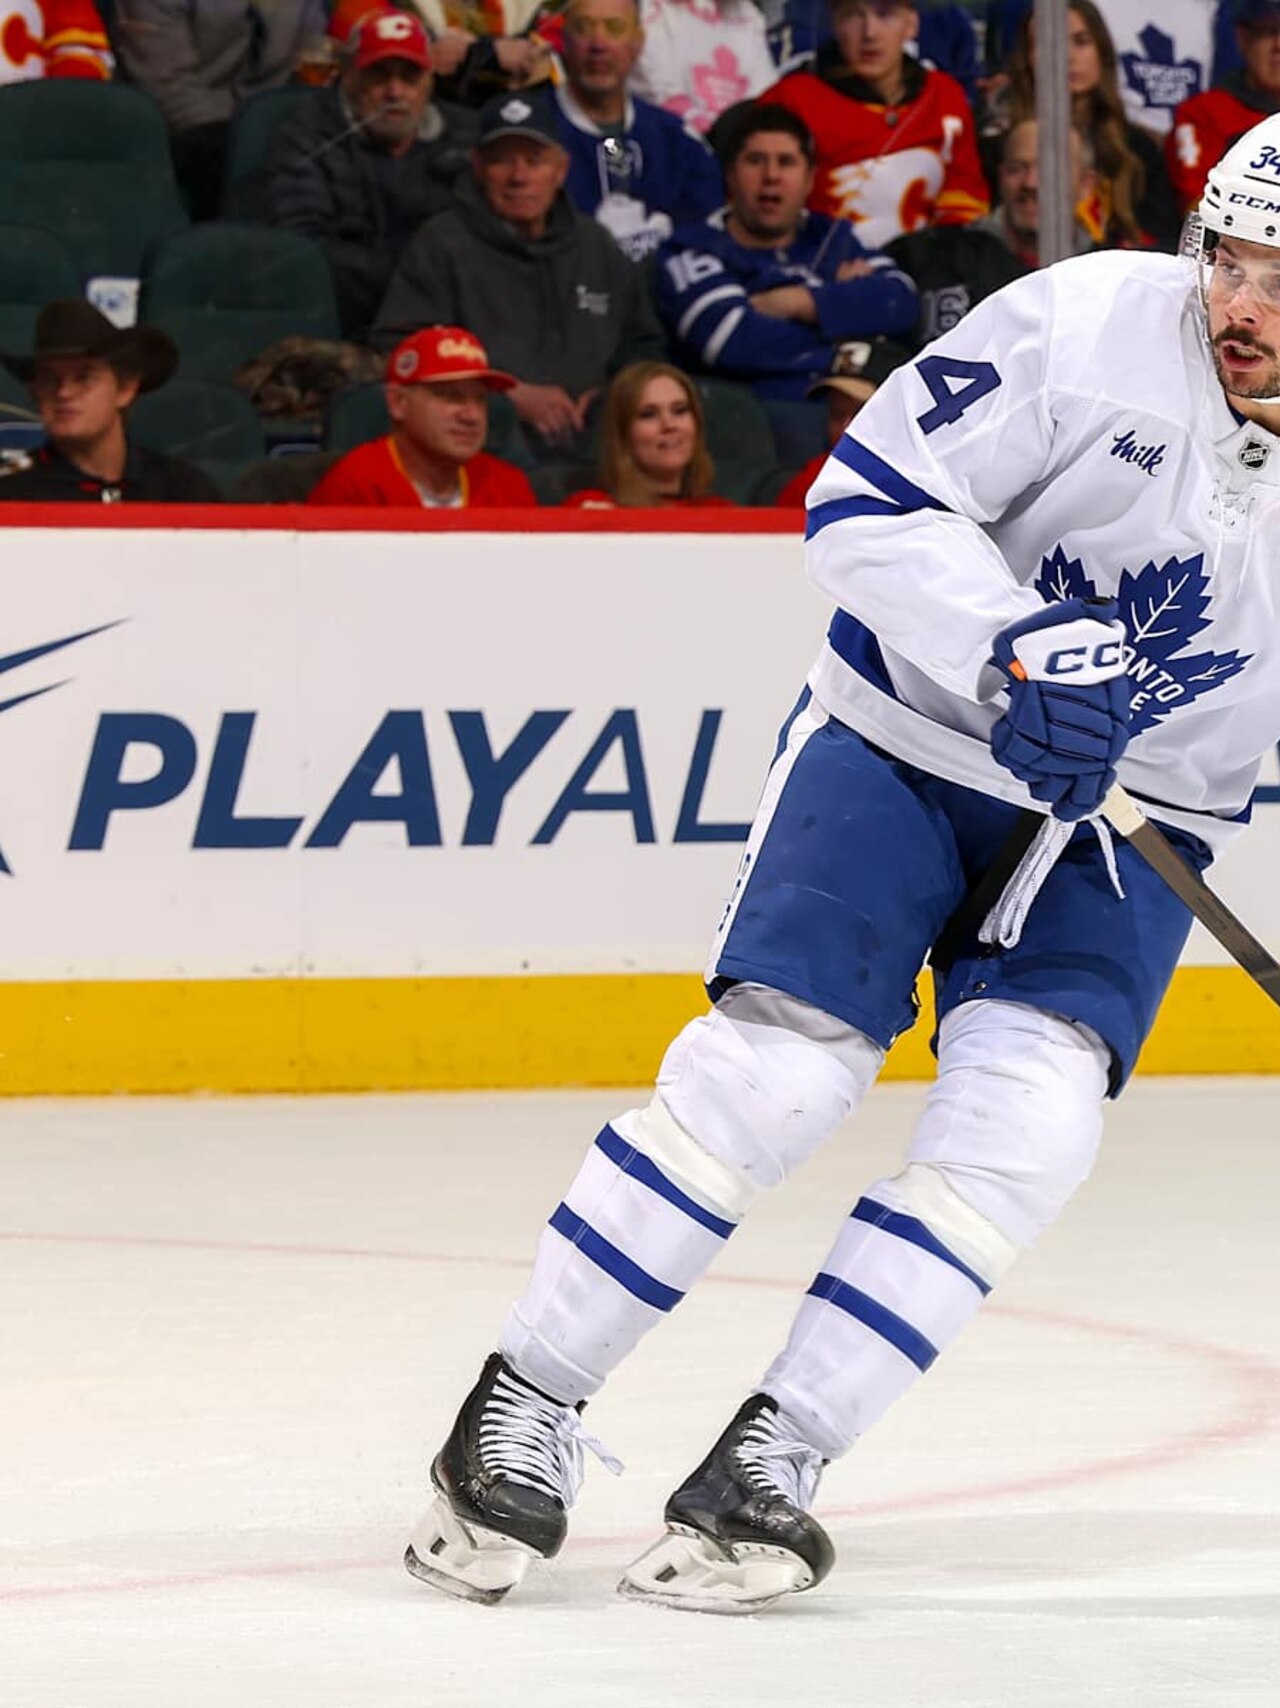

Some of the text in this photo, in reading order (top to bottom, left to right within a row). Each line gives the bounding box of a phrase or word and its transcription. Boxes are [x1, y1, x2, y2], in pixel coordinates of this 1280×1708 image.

[665, 249, 725, 293] 16
[914, 355, 1002, 435] 4
[1110, 429, 1167, 477] Milk
[67, 708, 753, 852] PLAYAL
